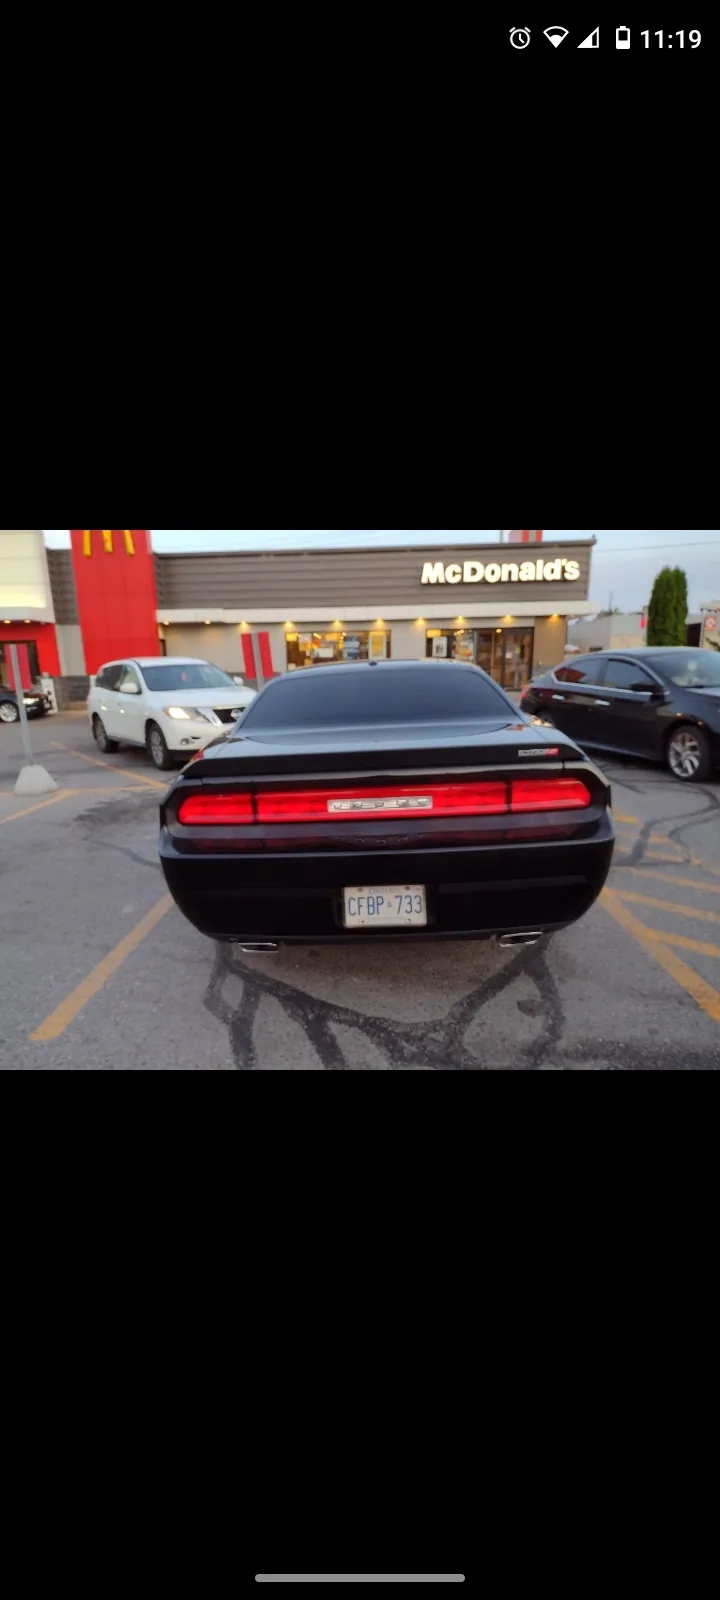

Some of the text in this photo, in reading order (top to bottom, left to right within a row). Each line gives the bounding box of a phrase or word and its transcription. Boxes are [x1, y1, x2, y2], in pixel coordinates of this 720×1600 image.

[420, 558, 581, 584] McDonald's
[348, 895, 423, 916] CFBP 733
